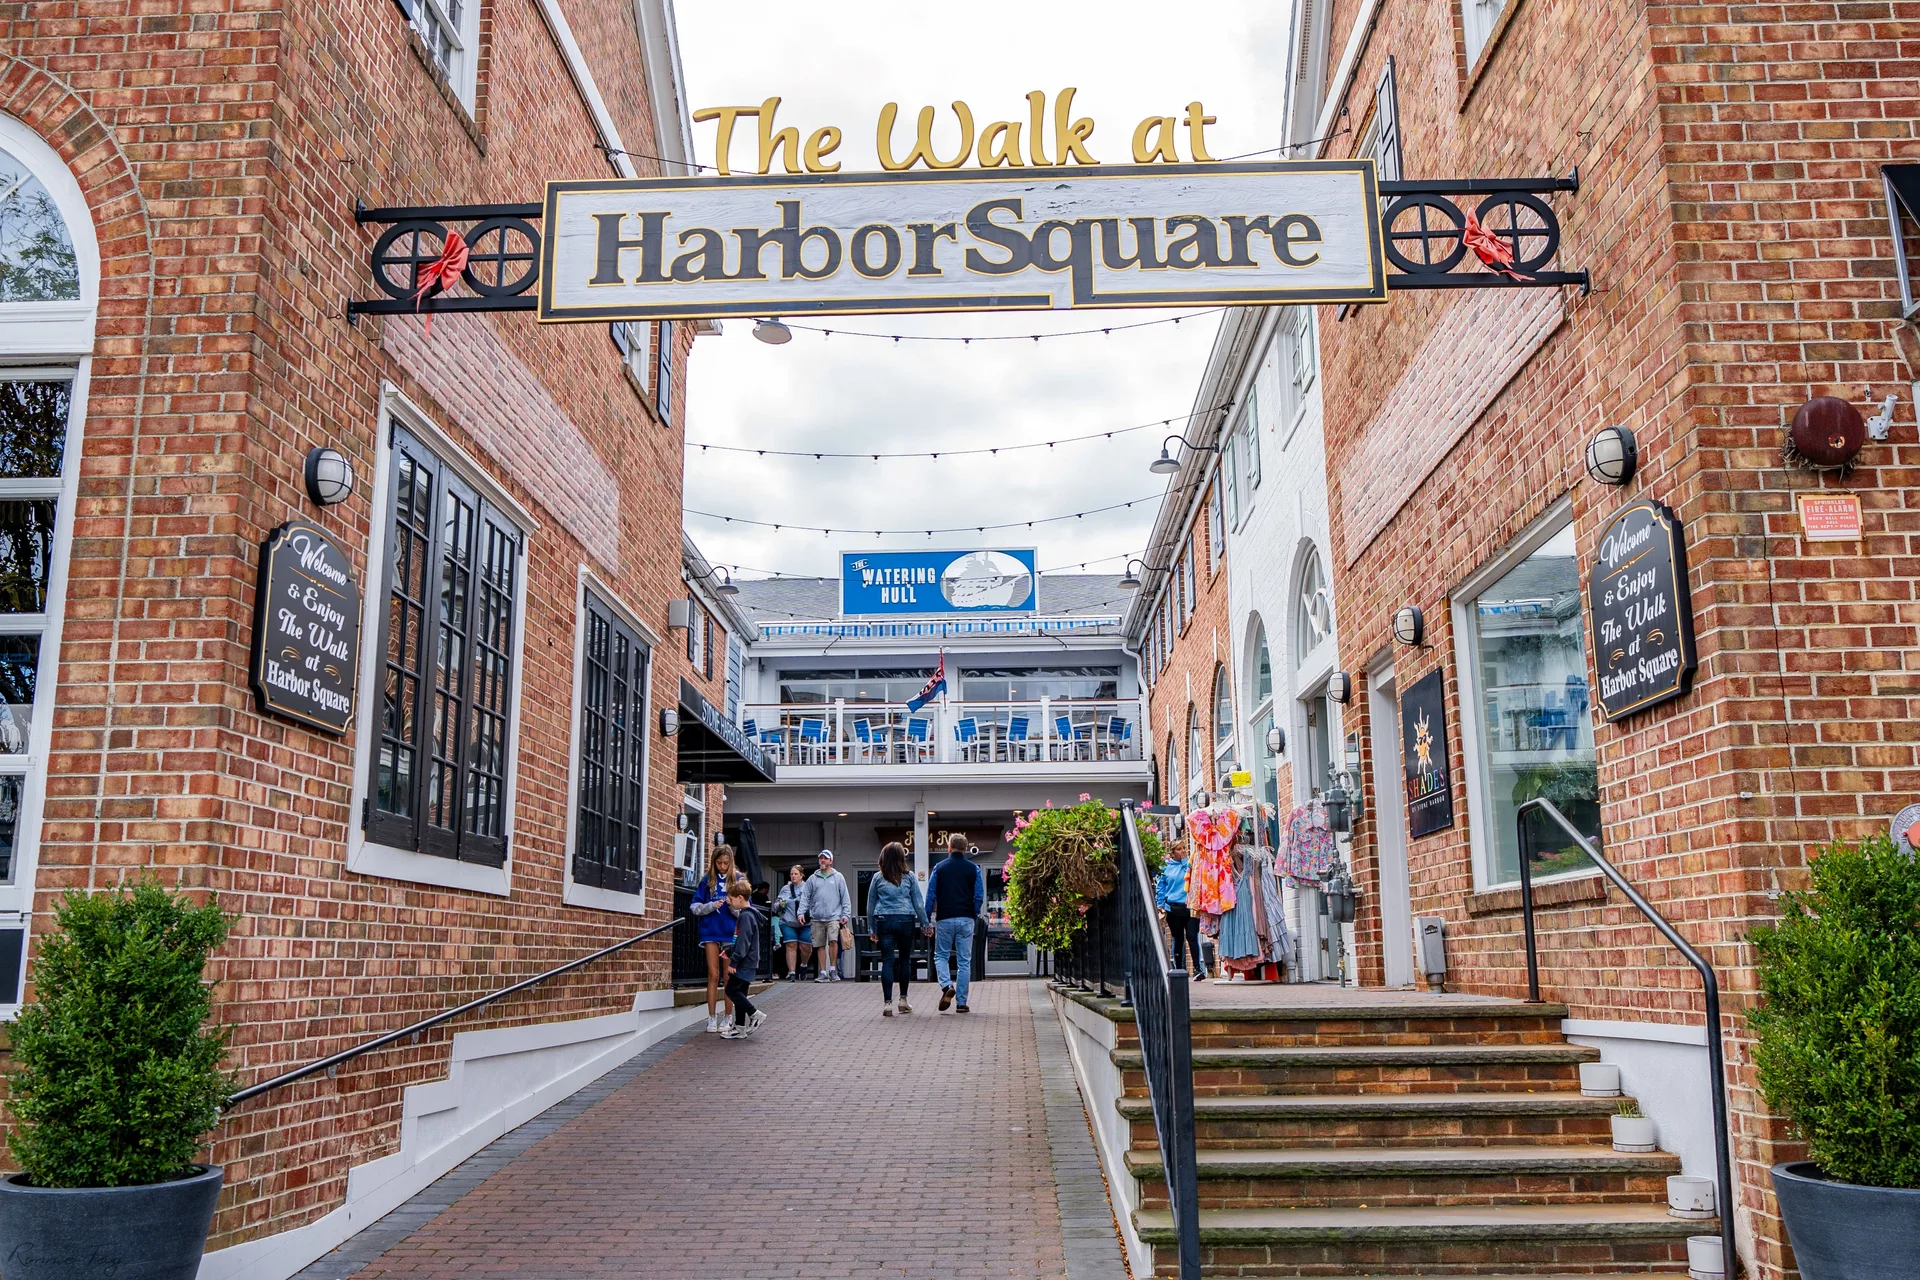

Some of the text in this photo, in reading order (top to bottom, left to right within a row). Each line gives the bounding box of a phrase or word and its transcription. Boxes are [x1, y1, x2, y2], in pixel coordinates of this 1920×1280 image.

[693, 86, 1220, 175] The Walk at
[292, 534, 347, 587] Welcome
[1600, 518, 1651, 569] Welcome
[862, 567, 936, 586] WATERING
[881, 586, 917, 604] HULL
[1604, 567, 1656, 607] & Enjoy
[287, 583, 346, 632] & Enjoy
[1600, 592, 1667, 646] The Walk
[278, 607, 349, 662] The Walk
[1628, 633, 1641, 657] at
[266, 659, 350, 714] Harbor Square
[305, 655, 321, 672] at
[1601, 647, 1679, 700] Harbor Square
[1408, 766, 1445, 800] SHADES
